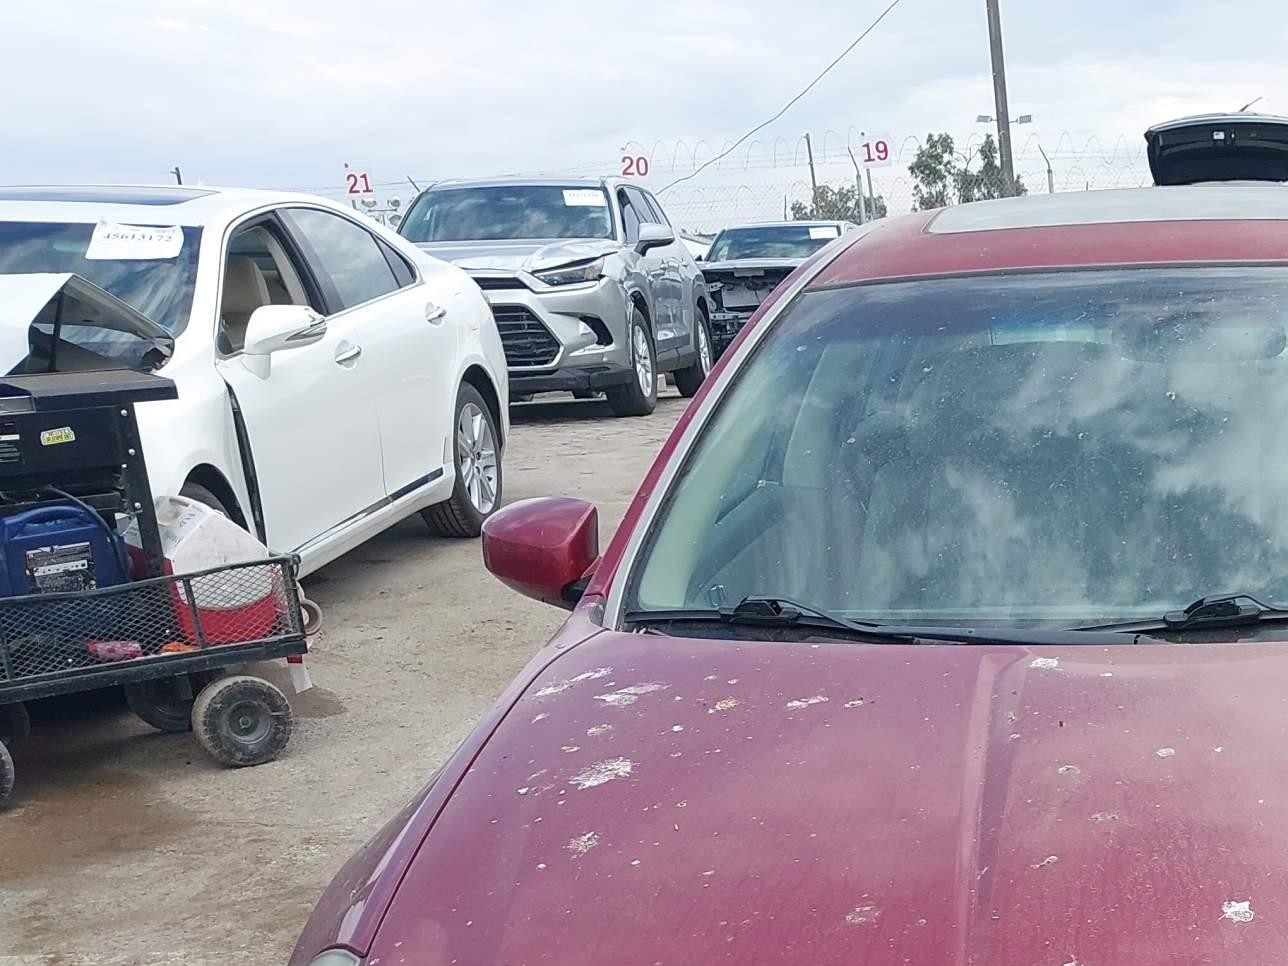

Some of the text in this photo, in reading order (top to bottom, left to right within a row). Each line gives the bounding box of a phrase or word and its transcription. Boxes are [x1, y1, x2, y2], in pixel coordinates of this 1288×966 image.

[862, 140, 889, 162] 19
[621, 156, 649, 176] 20
[346, 173, 374, 193] 21
